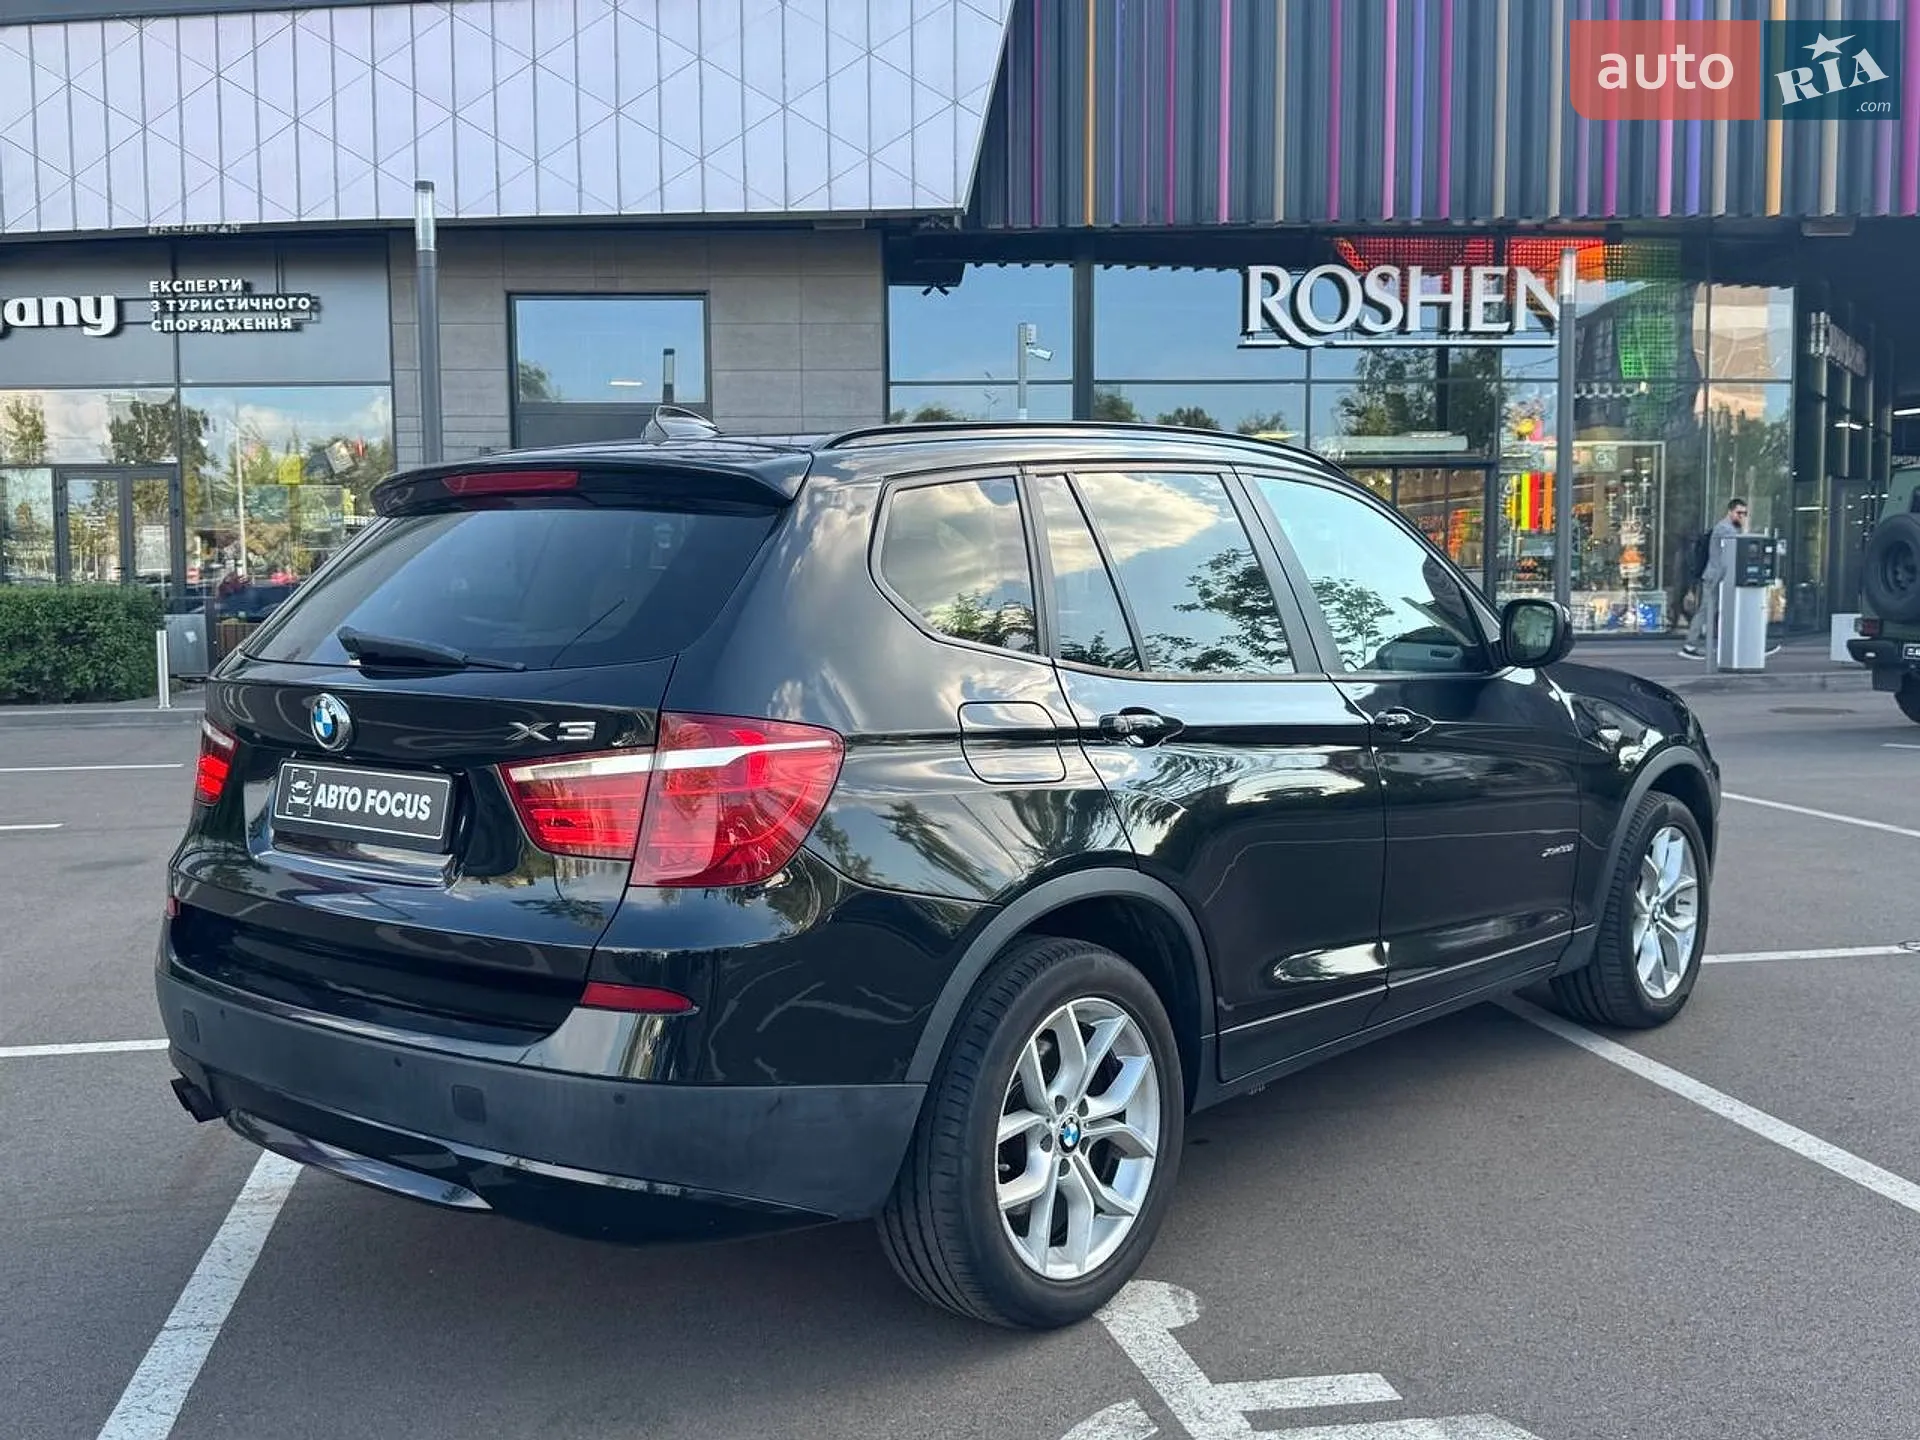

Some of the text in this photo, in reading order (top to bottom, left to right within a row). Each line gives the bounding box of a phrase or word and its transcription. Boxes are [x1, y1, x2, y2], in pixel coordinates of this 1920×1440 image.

[149, 279, 242, 293] ЕКСПЕРТИ
[166, 297, 311, 312] ТУРИСТИЧНОГО
[1247, 264, 1559, 347] ROSHEN
[0, 295, 116, 336] any
[151, 317, 293, 333] СПОРЯДЖЕННЯ
[504, 721, 597, 742] X3
[364, 789, 432, 821] FOCUS
